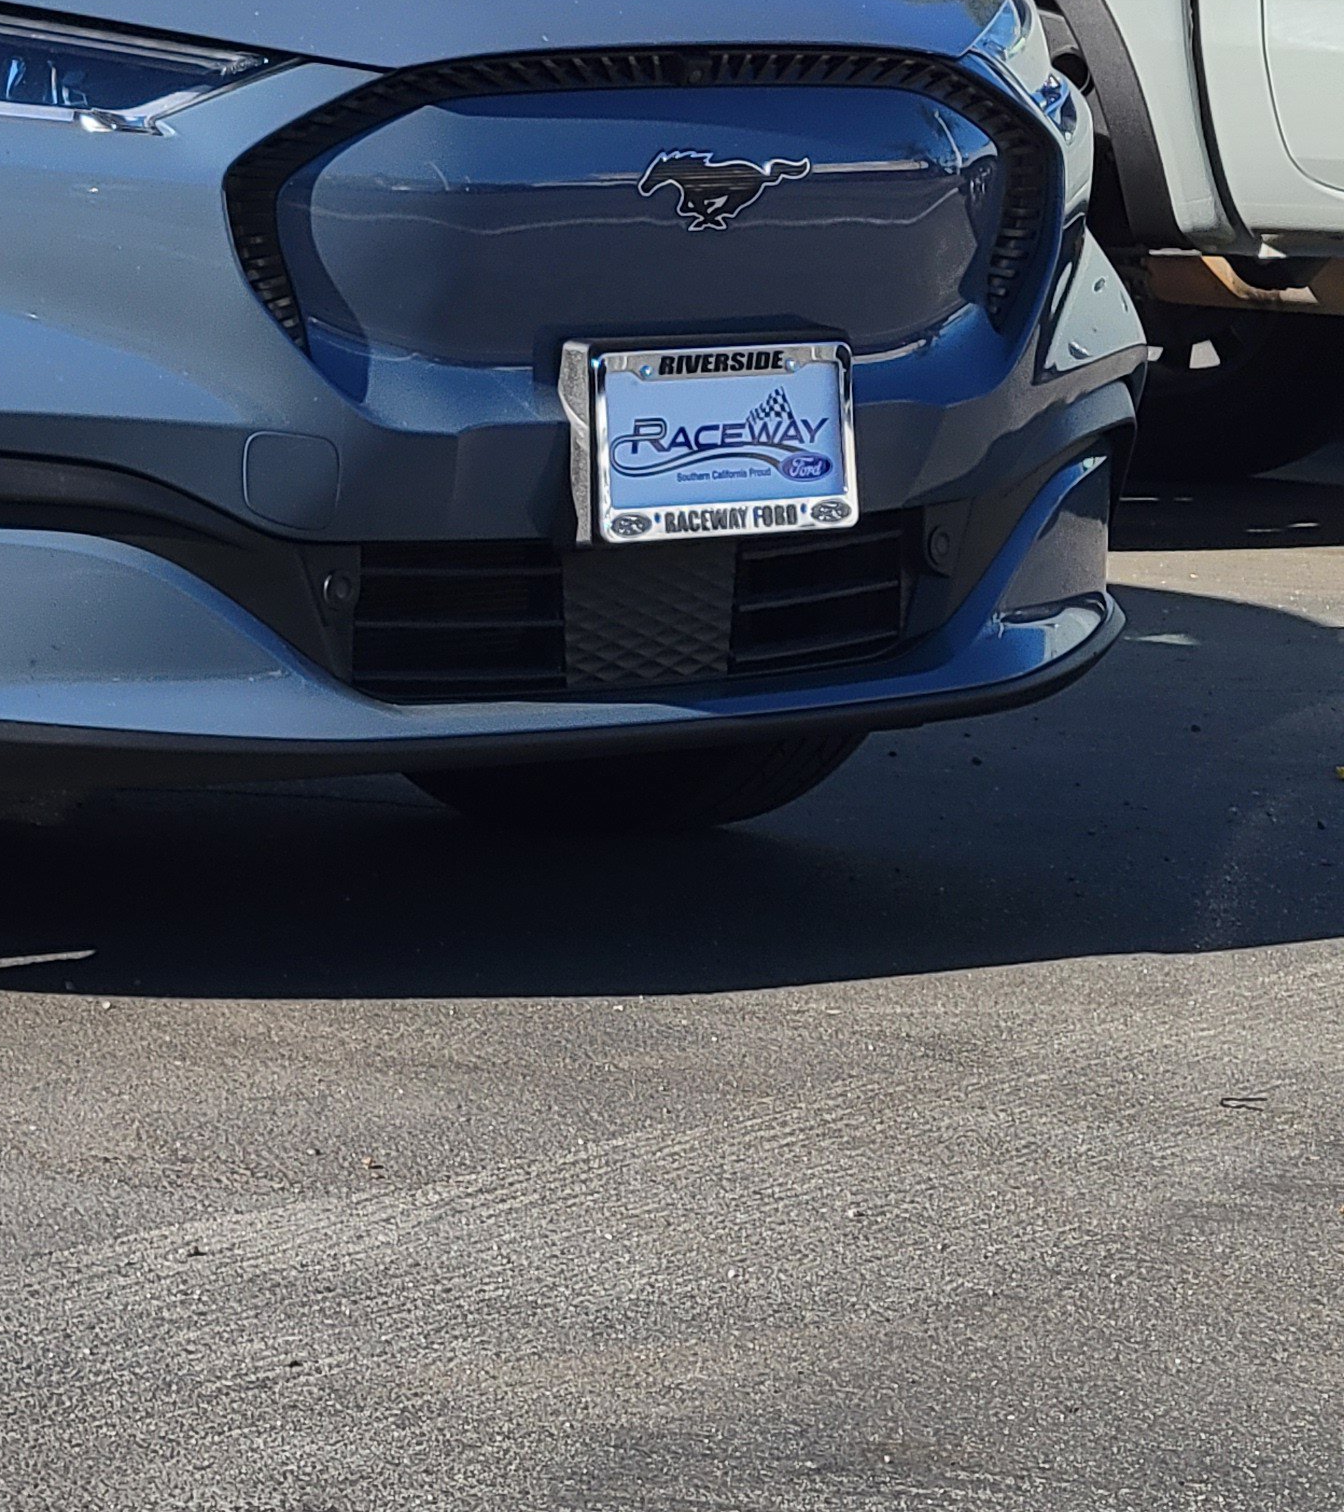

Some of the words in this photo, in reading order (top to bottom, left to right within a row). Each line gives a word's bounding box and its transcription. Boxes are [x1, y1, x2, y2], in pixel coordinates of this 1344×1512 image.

[658, 350, 784, 376] RIVERSIDE
[677, 473, 711, 483] Southern
[713, 470, 748, 481] California
[749, 467, 772, 478] Proud
[788, 456, 823, 477] Ford
[664, 506, 749, 534] RACEWAY
[753, 504, 799, 528] FORD
